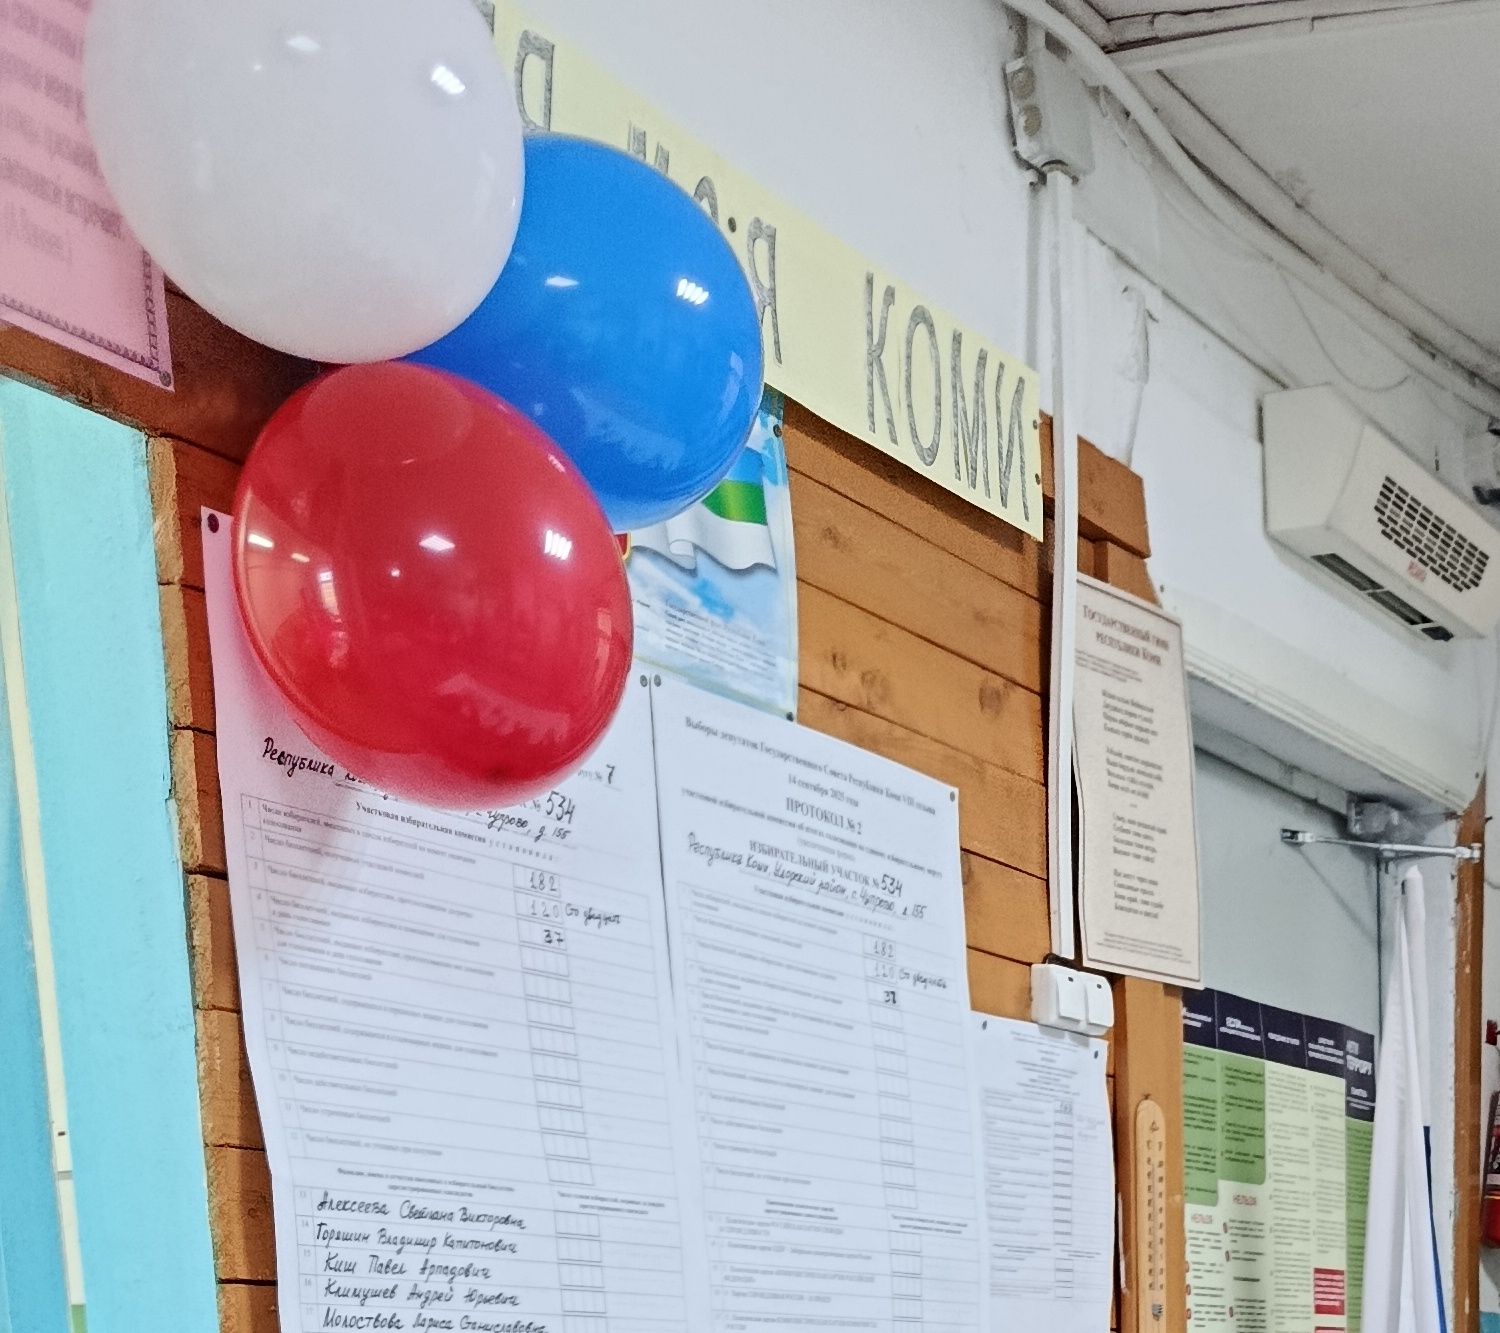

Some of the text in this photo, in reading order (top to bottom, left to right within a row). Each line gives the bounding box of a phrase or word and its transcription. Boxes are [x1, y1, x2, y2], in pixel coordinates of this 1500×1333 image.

[864, 272, 1030, 523] КОМИ
[262, 737, 335, 778] Республика
[606, 763, 616, 785] 7
[356, 801, 399, 822] Участковая
[401, 814, 452, 836] избирательная
[545, 789, 576, 825] 534
[786, 797, 844, 829] ПРОТОКОЛ
[857, 822, 863, 836] 2
[552, 826, 572, 840] 155
[529, 871, 558, 892] 182
[688, 831, 743, 867] Республика
[911, 903, 928, 919] 155
[749, 840, 829, 875] ИЗБИРАТЕЛЬНЫЙ
[831, 864, 870, 887] УЧАСТОК
[881, 873, 903, 898] 534
[530, 900, 560, 919] 120
[543, 929, 564, 946] 37
[873, 940, 894, 958] 182
[399, 1199, 454, 1222] Светлана
[458, 1206, 527, 1230] Викторовна
[377, 1228, 437, 1256] Владимир
[442, 1231, 518, 1254] Капитонович
[324, 1251, 358, 1274] Киш
[368, 1254, 407, 1275] Павел
[419, 1257, 492, 1283] Арпадович
[324, 1277, 397, 1306] Климушев
[406, 1282, 454, 1307] Андрей
[463, 1286, 520, 1308] Юрьевич
[323, 1306, 404, 1330] Молоствова
